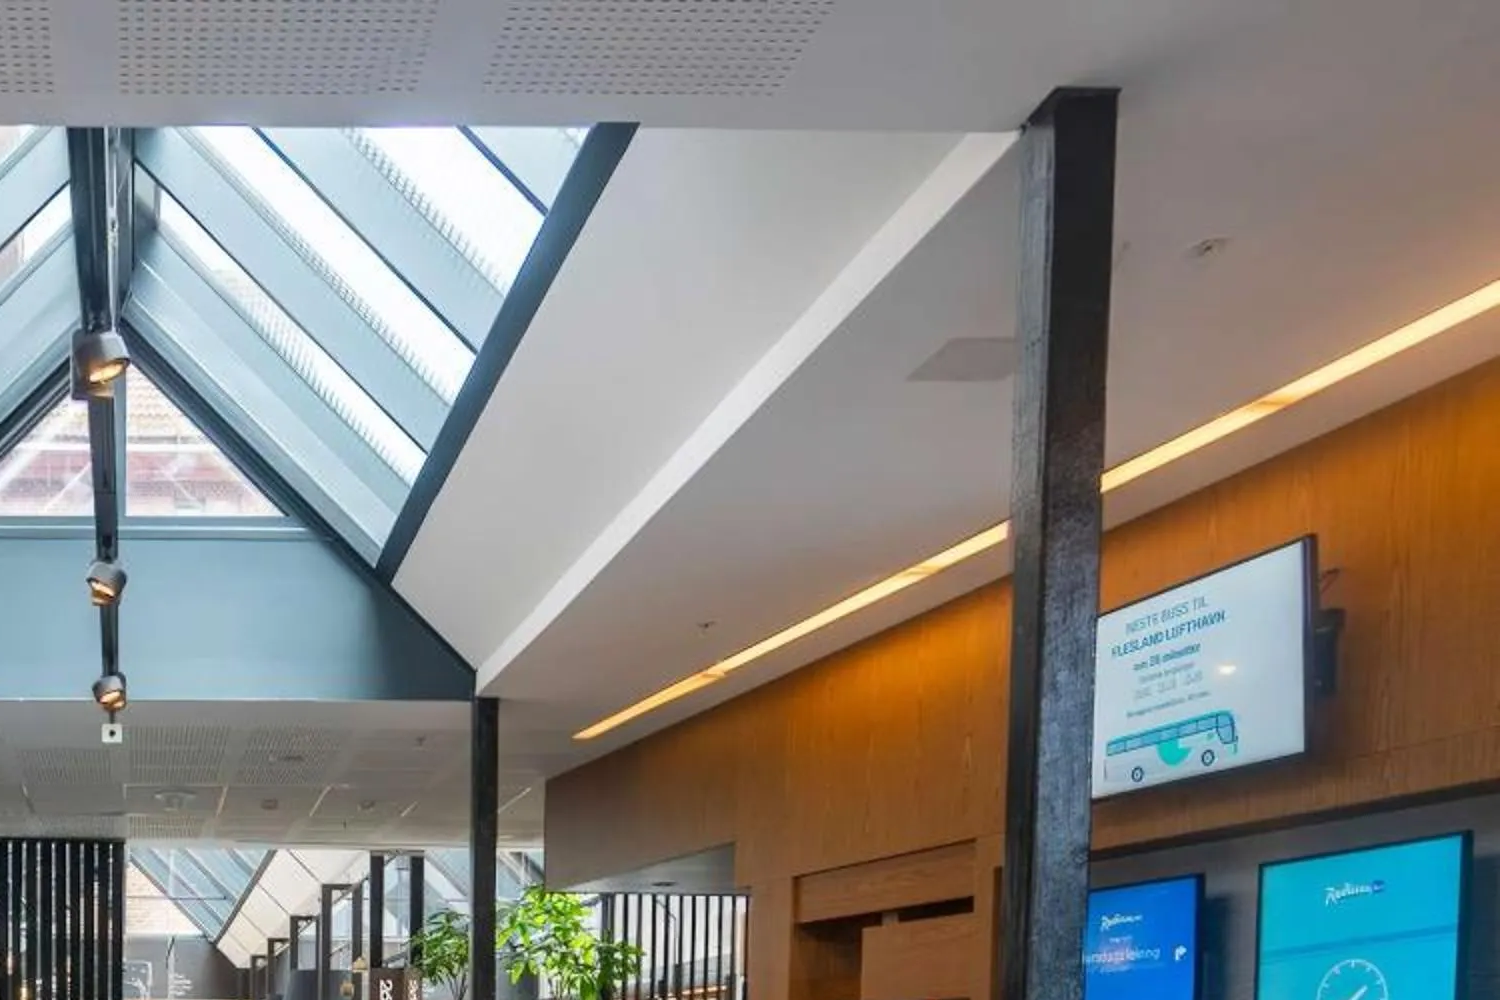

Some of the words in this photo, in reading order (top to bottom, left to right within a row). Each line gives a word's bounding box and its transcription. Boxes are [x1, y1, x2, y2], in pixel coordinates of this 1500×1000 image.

[1161, 601, 1189, 622] BUSS
[1193, 596, 1209, 612] TIL
[1111, 631, 1164, 658] FLESLAND
[1165, 610, 1226, 641] LUFTHAVN
